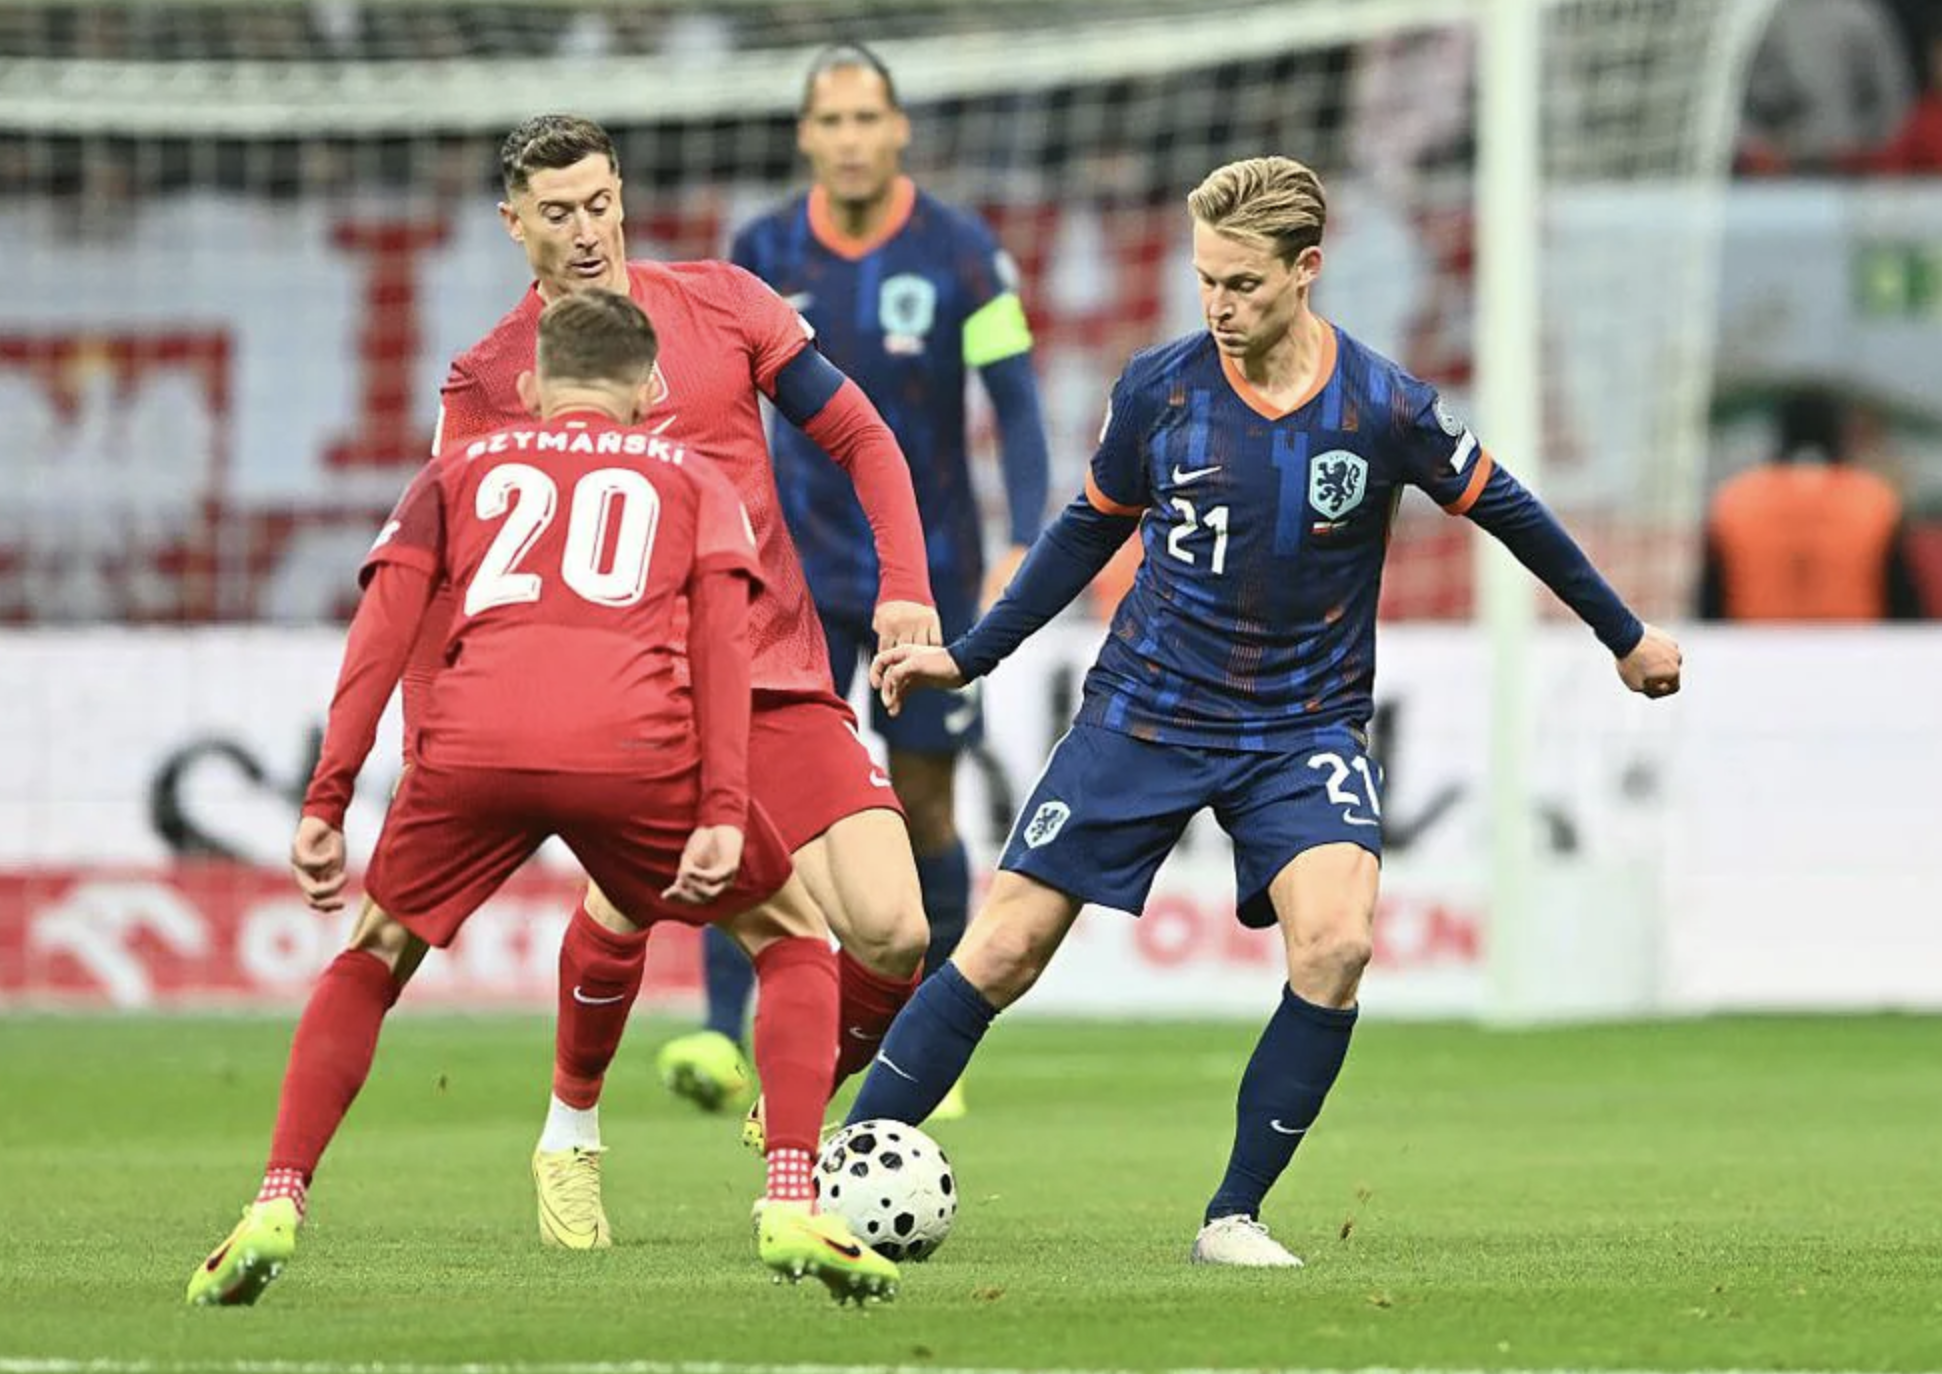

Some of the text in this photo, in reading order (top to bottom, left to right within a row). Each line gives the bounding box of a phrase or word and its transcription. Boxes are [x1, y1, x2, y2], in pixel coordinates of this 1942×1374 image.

[463, 462, 661, 617] 20
[1167, 497, 1229, 575] 21
[1307, 752, 1381, 817] 21
